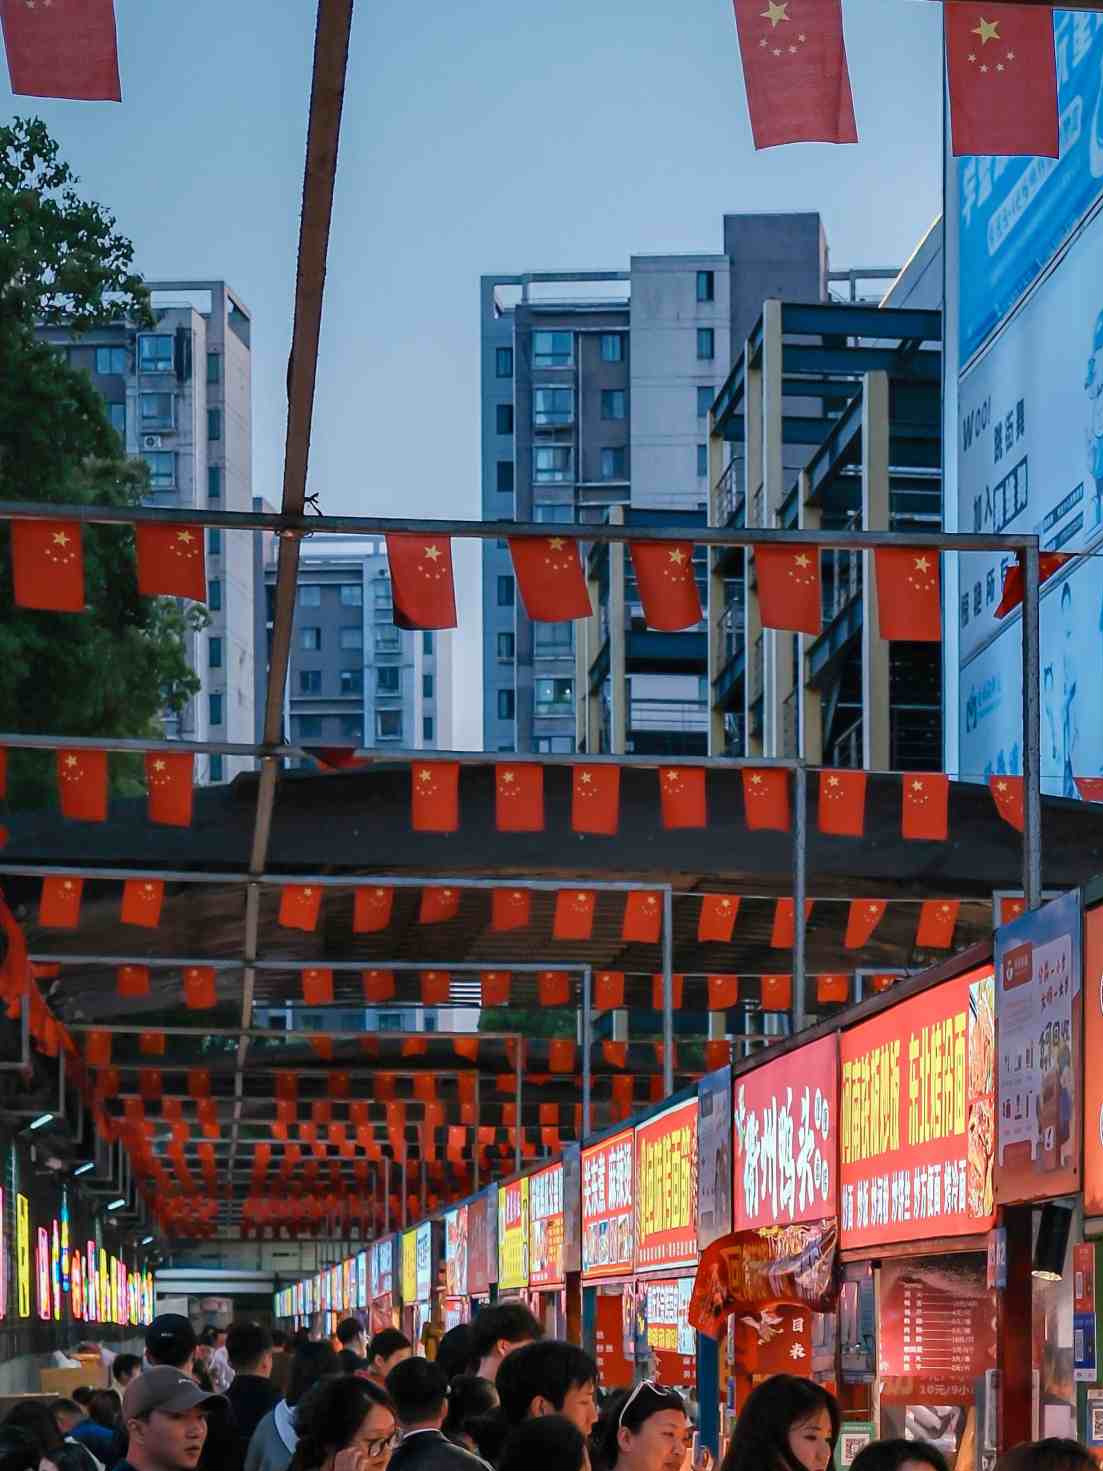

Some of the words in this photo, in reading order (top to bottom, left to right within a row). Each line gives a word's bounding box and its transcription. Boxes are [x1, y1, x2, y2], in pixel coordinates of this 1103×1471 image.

[908, 1012, 967, 1146] 东北烤冷面
